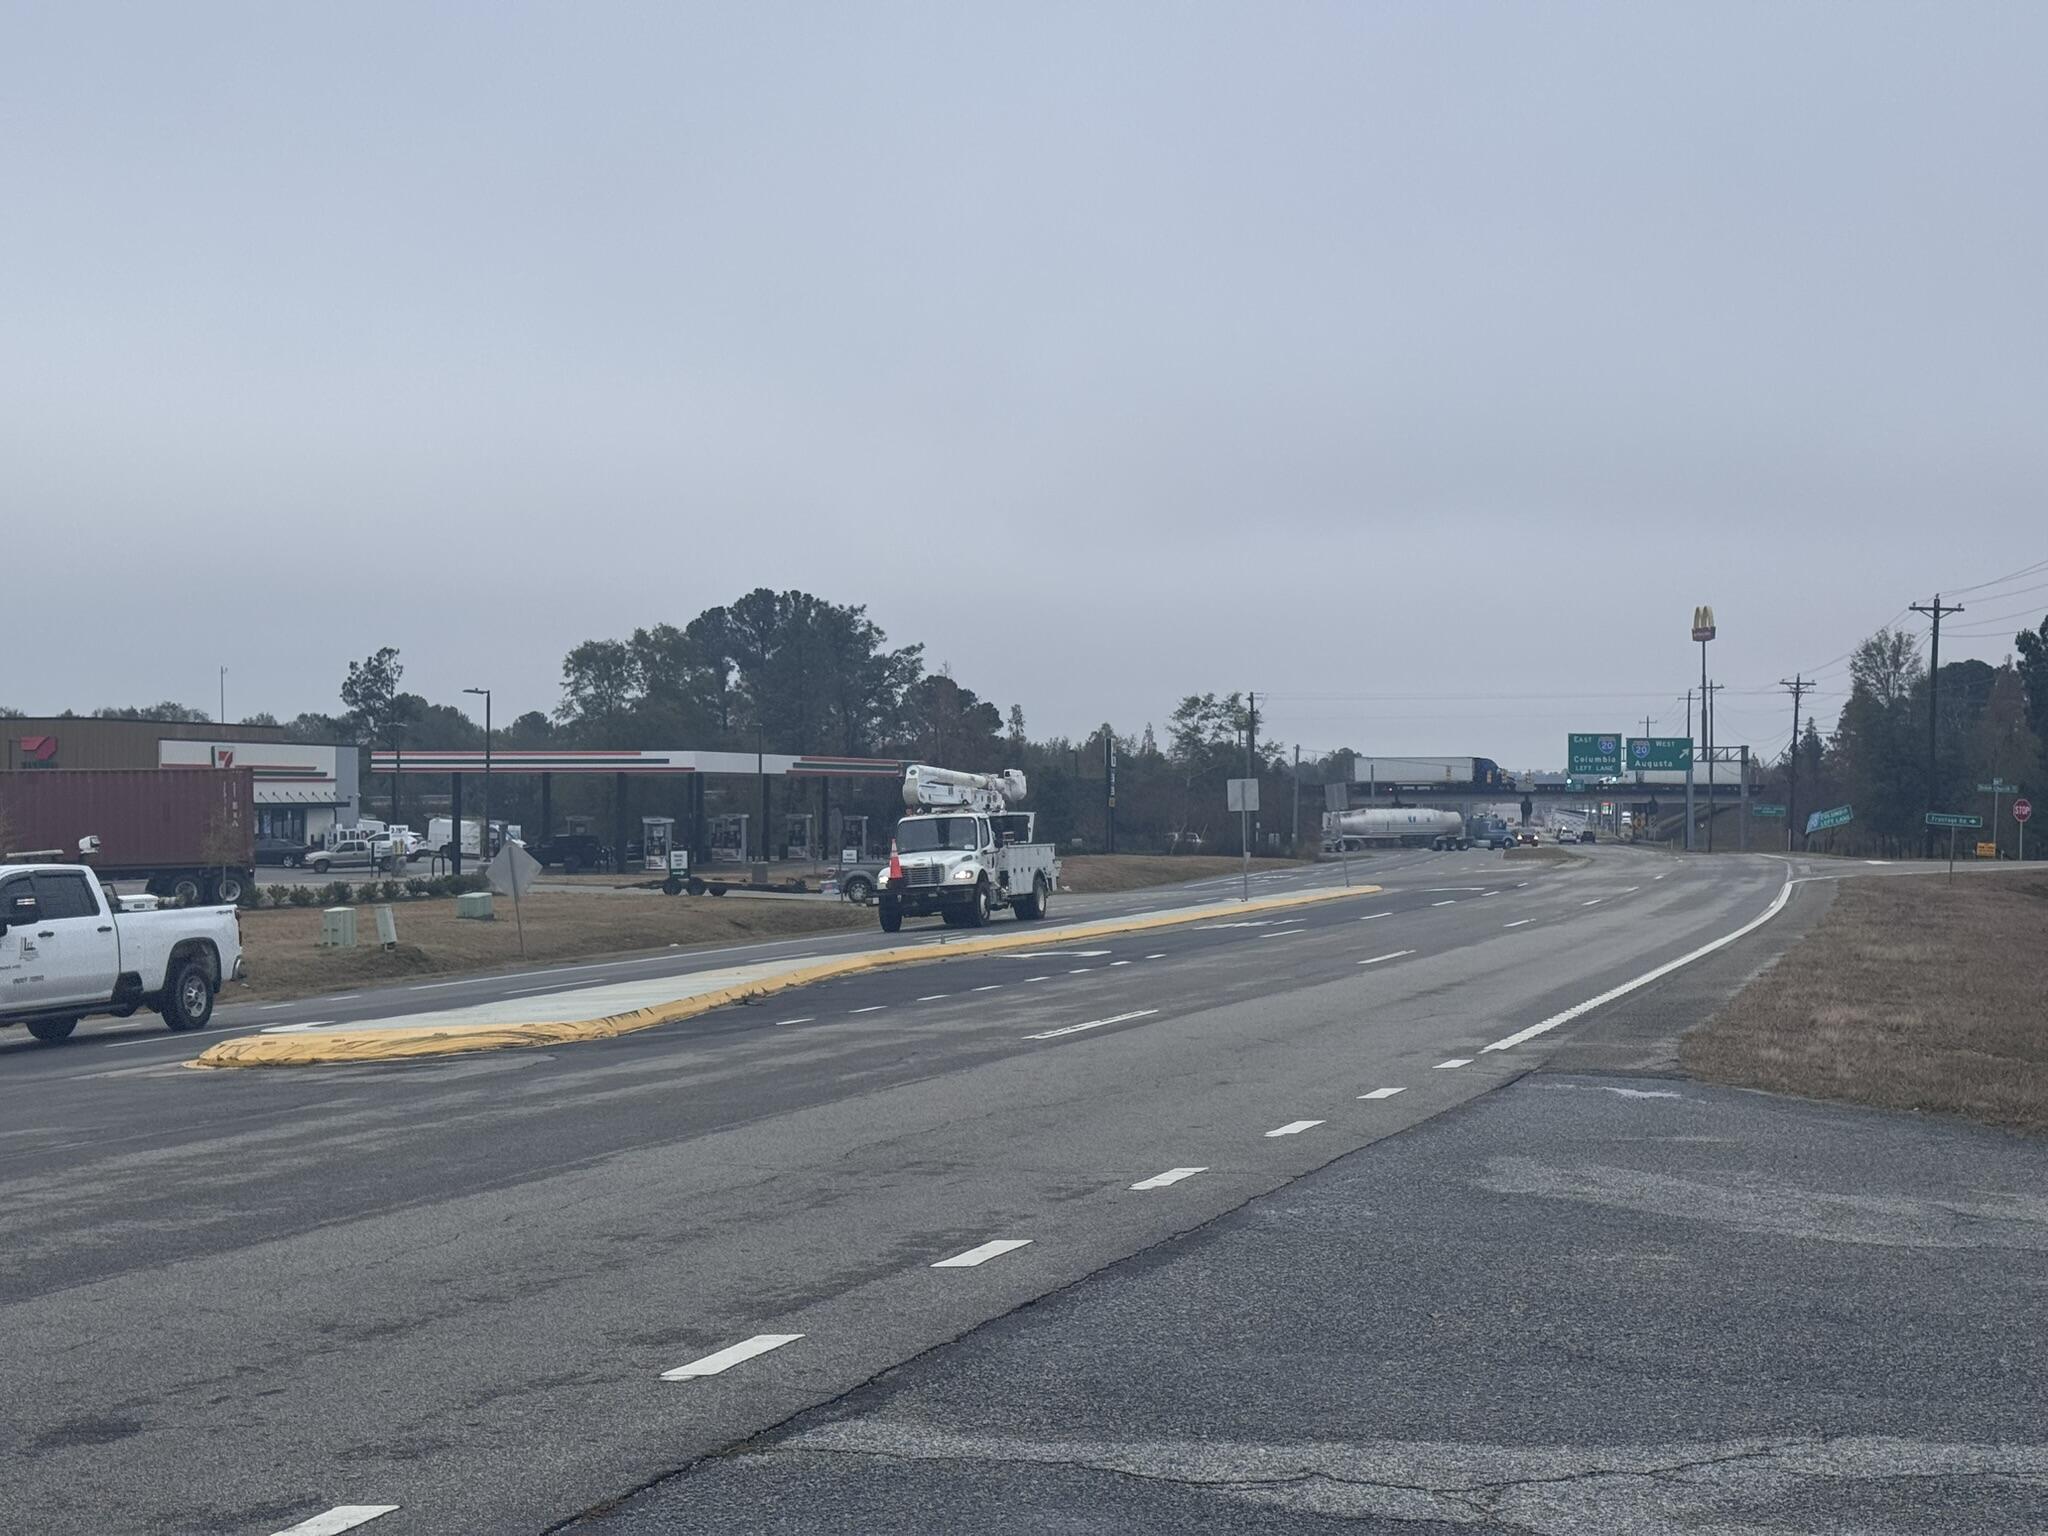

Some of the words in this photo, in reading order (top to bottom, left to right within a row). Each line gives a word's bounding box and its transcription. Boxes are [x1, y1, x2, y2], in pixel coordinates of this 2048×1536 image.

[1601, 742, 1613, 750] 20
[1635, 745, 1647, 754] 20
[1573, 755, 1616, 763] Columbia
[1634, 760, 1673, 769] Augusta
[2015, 805, 2031, 815] STOP
